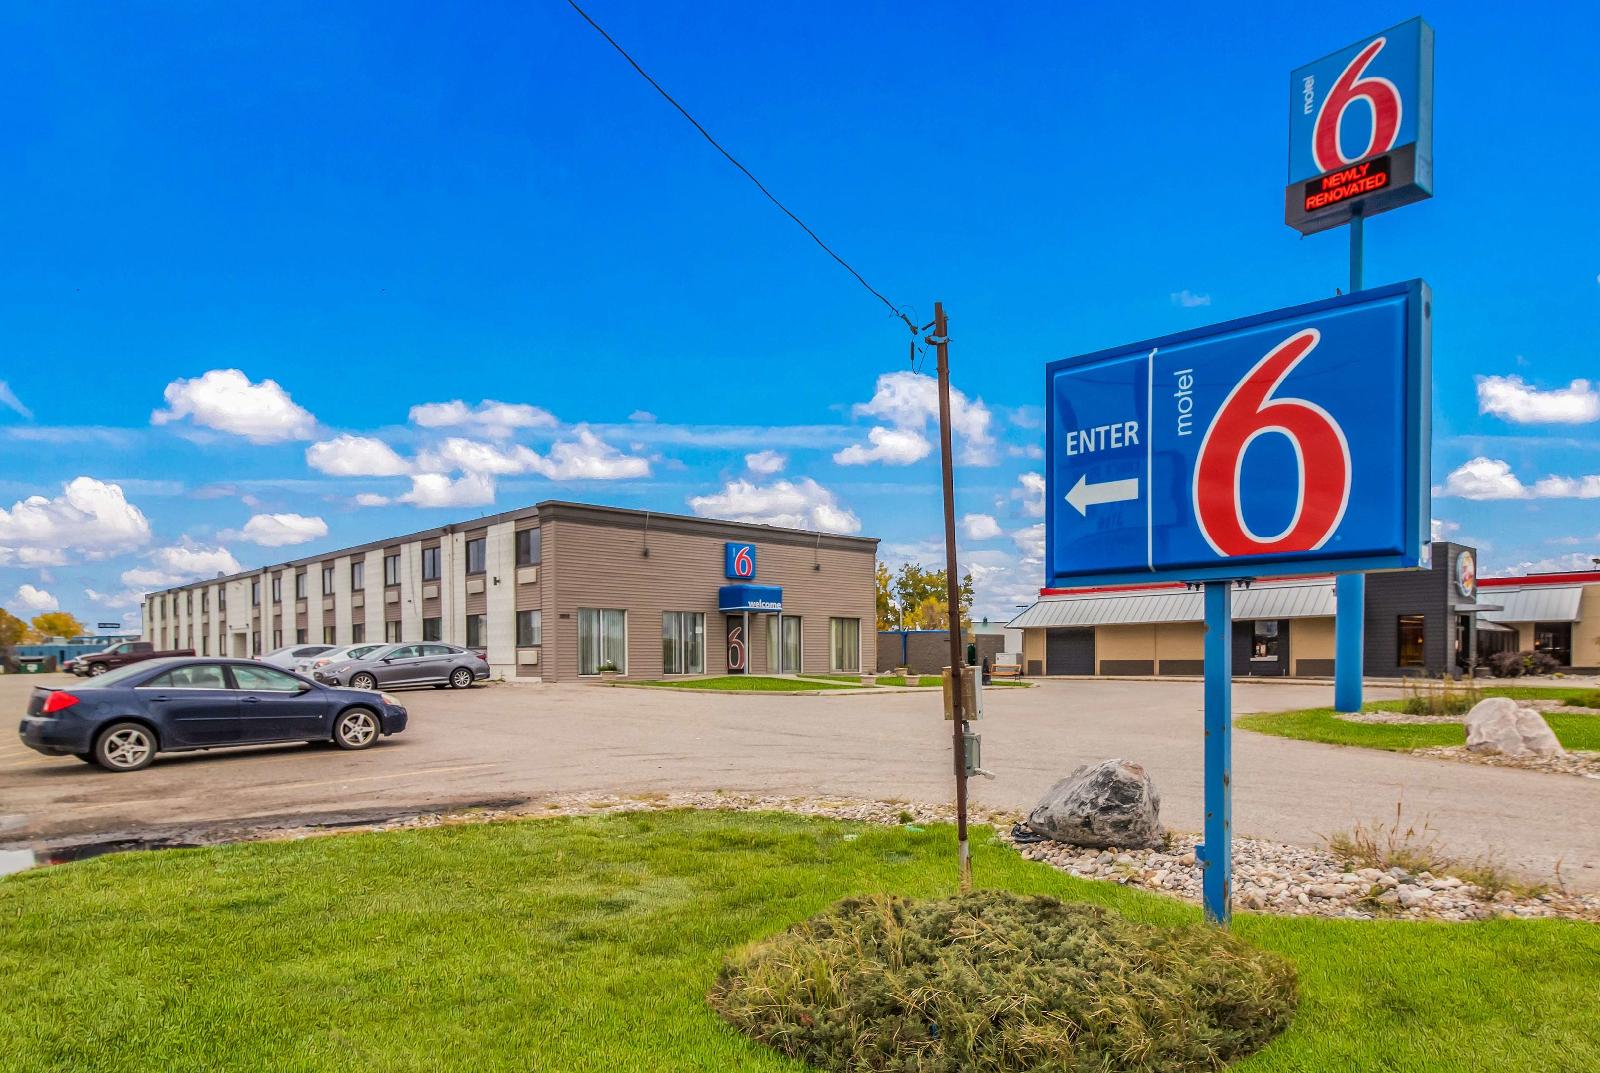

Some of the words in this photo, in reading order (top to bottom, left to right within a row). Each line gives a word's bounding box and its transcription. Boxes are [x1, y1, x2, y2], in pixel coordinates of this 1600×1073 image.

[1303, 75, 1314, 114] motel
[1312, 36, 1402, 173] 6
[1305, 172, 1387, 210] RENOVATED
[1322, 162, 1370, 190] NEWLY
[1066, 420, 1139, 456] ENTER
[1174, 367, 1193, 437] motel
[1192, 328, 1352, 557] 6
[735, 546, 753, 577] 6
[748, 599, 782, 609] welcome
[729, 626, 745, 669] 6
